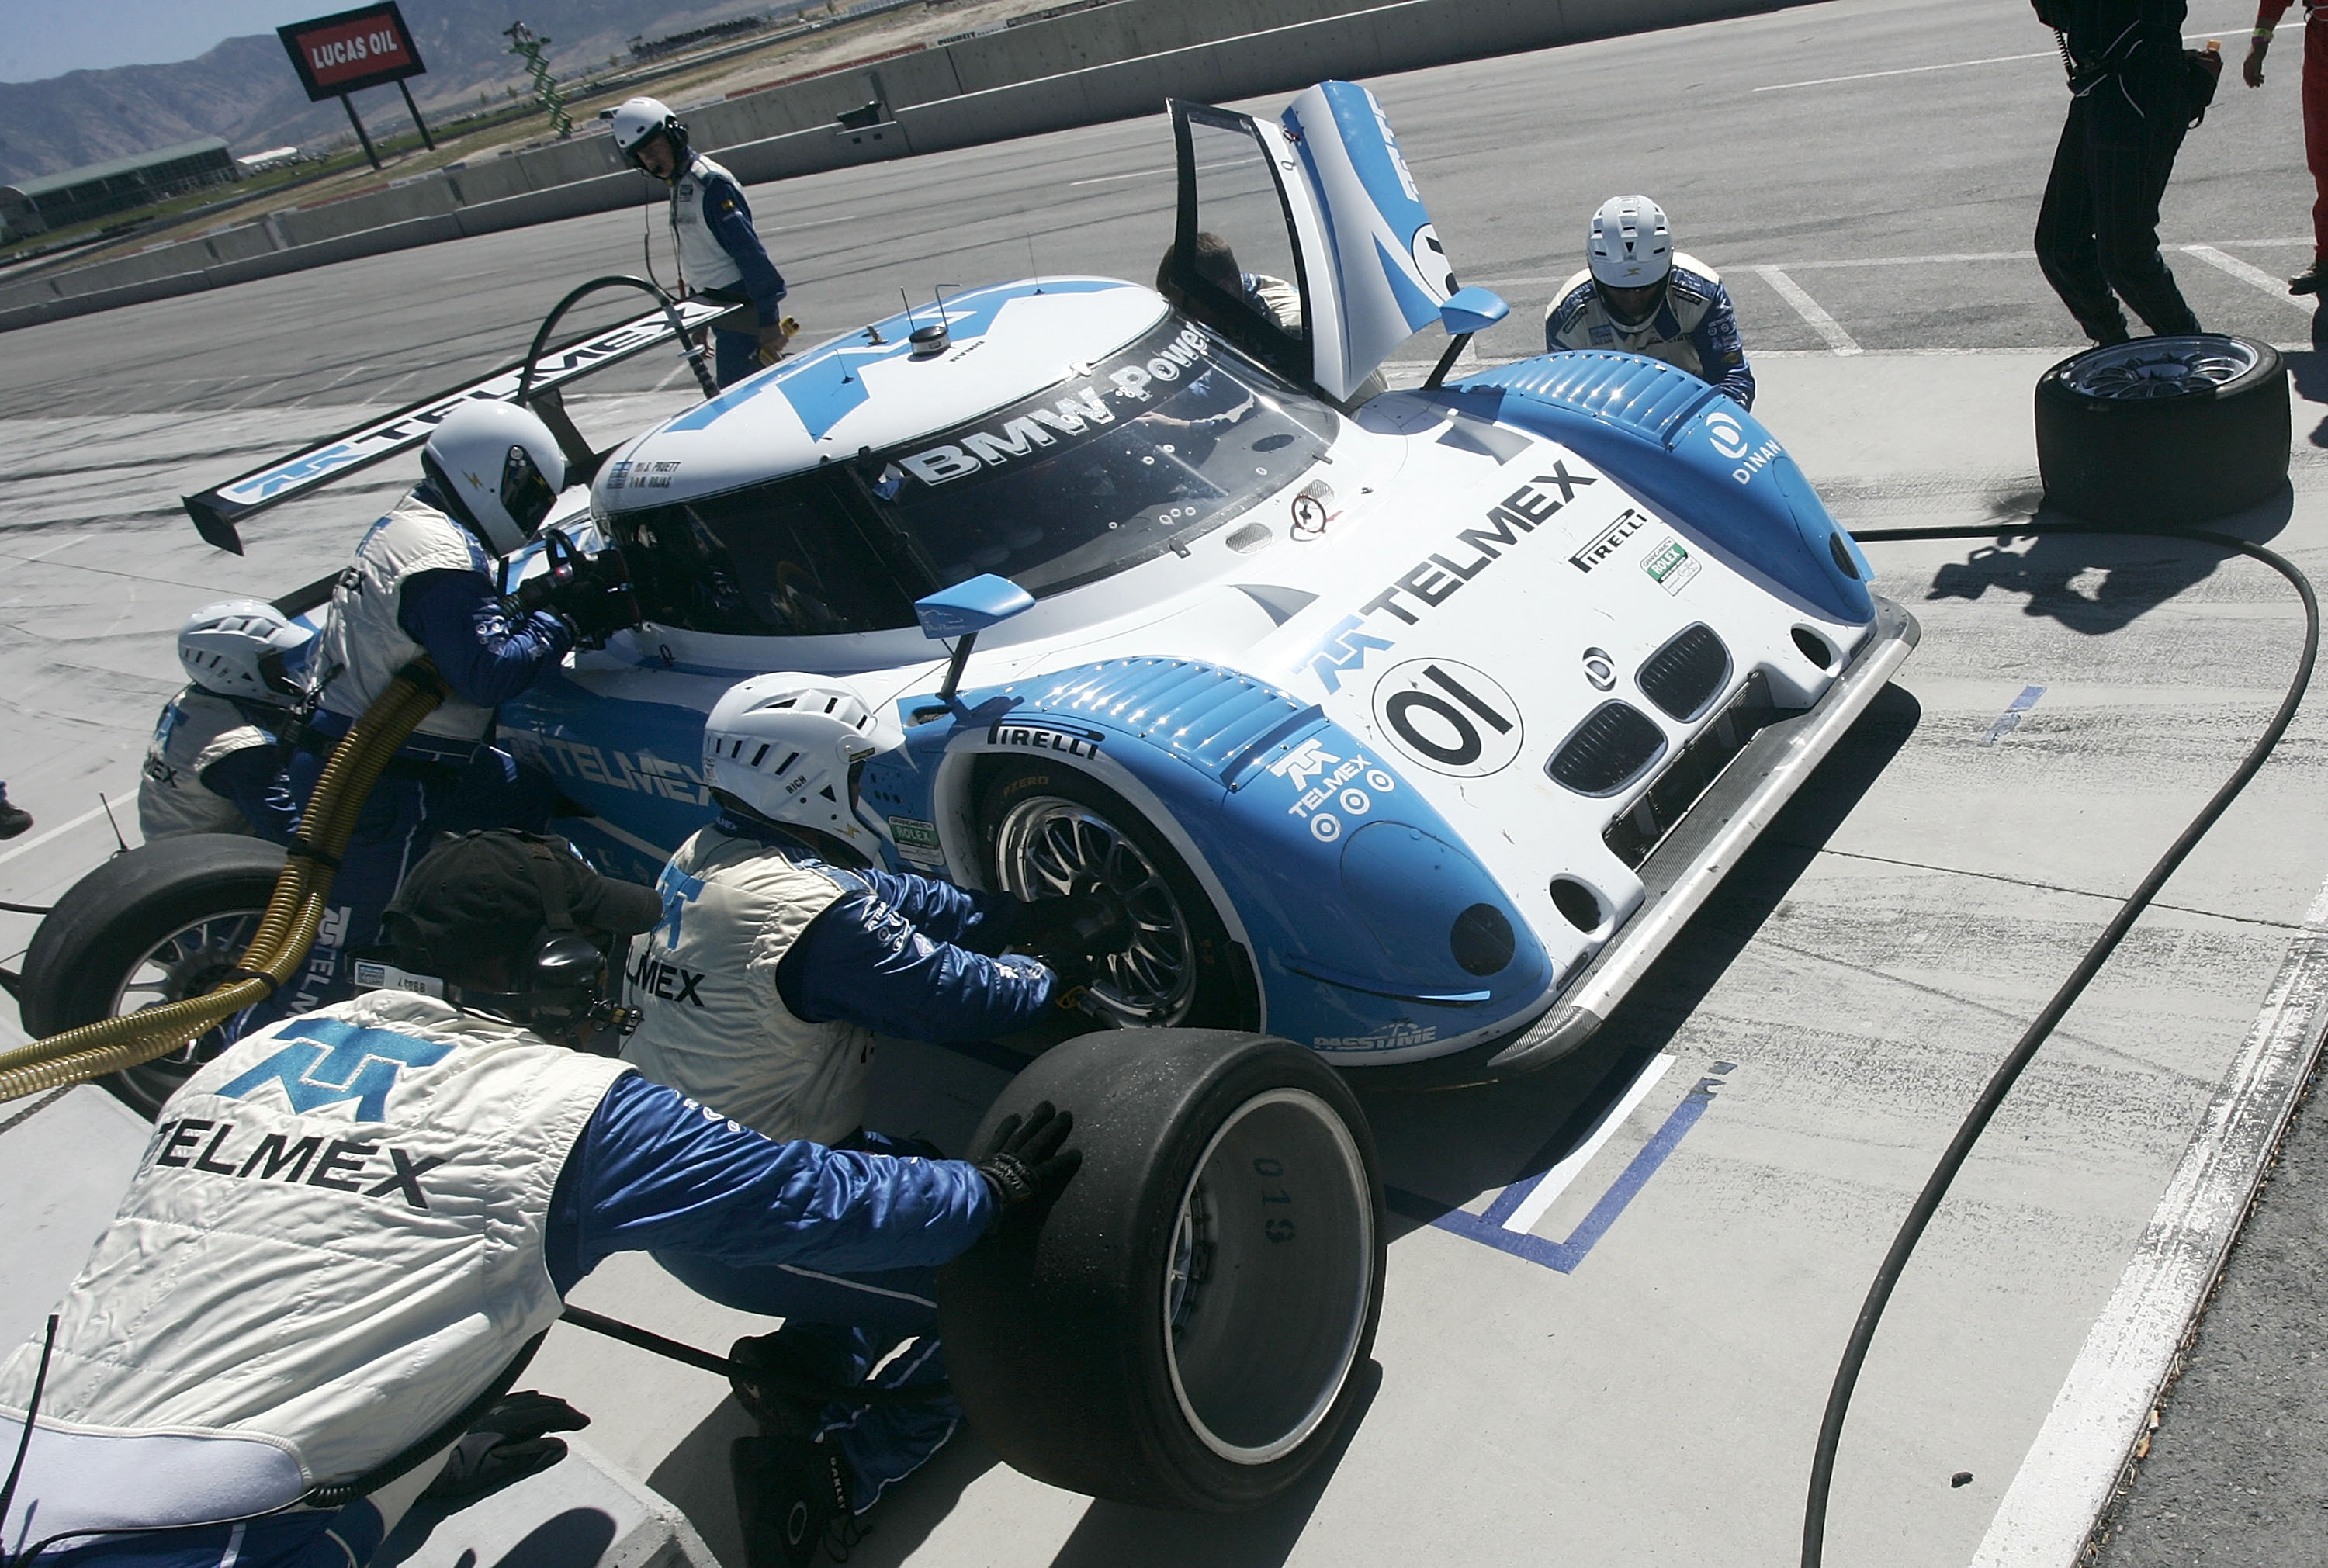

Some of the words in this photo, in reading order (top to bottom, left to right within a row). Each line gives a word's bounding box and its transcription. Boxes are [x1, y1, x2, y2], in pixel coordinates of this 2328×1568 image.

[312, 36, 367, 69] LUCAS
[369, 30, 397, 55] OIL
[899, 386, 1116, 486] BMW
[1110, 320, 1211, 402] Power
[1731, 439, 1782, 486] DINAN
[1358, 459, 1599, 626] TELMEX
[1568, 508, 1648, 574] PIRELLI
[1651, 548, 1681, 576] ROLEX
[987, 718, 1106, 761] PIRELLI
[1386, 664, 1514, 767] 01
[785, 775, 808, 794] RICH
[1287, 753, 1373, 819] TELMEX
[896, 826, 930, 842] ROLEX
[830, 1456, 845, 1509] OAKLEY
